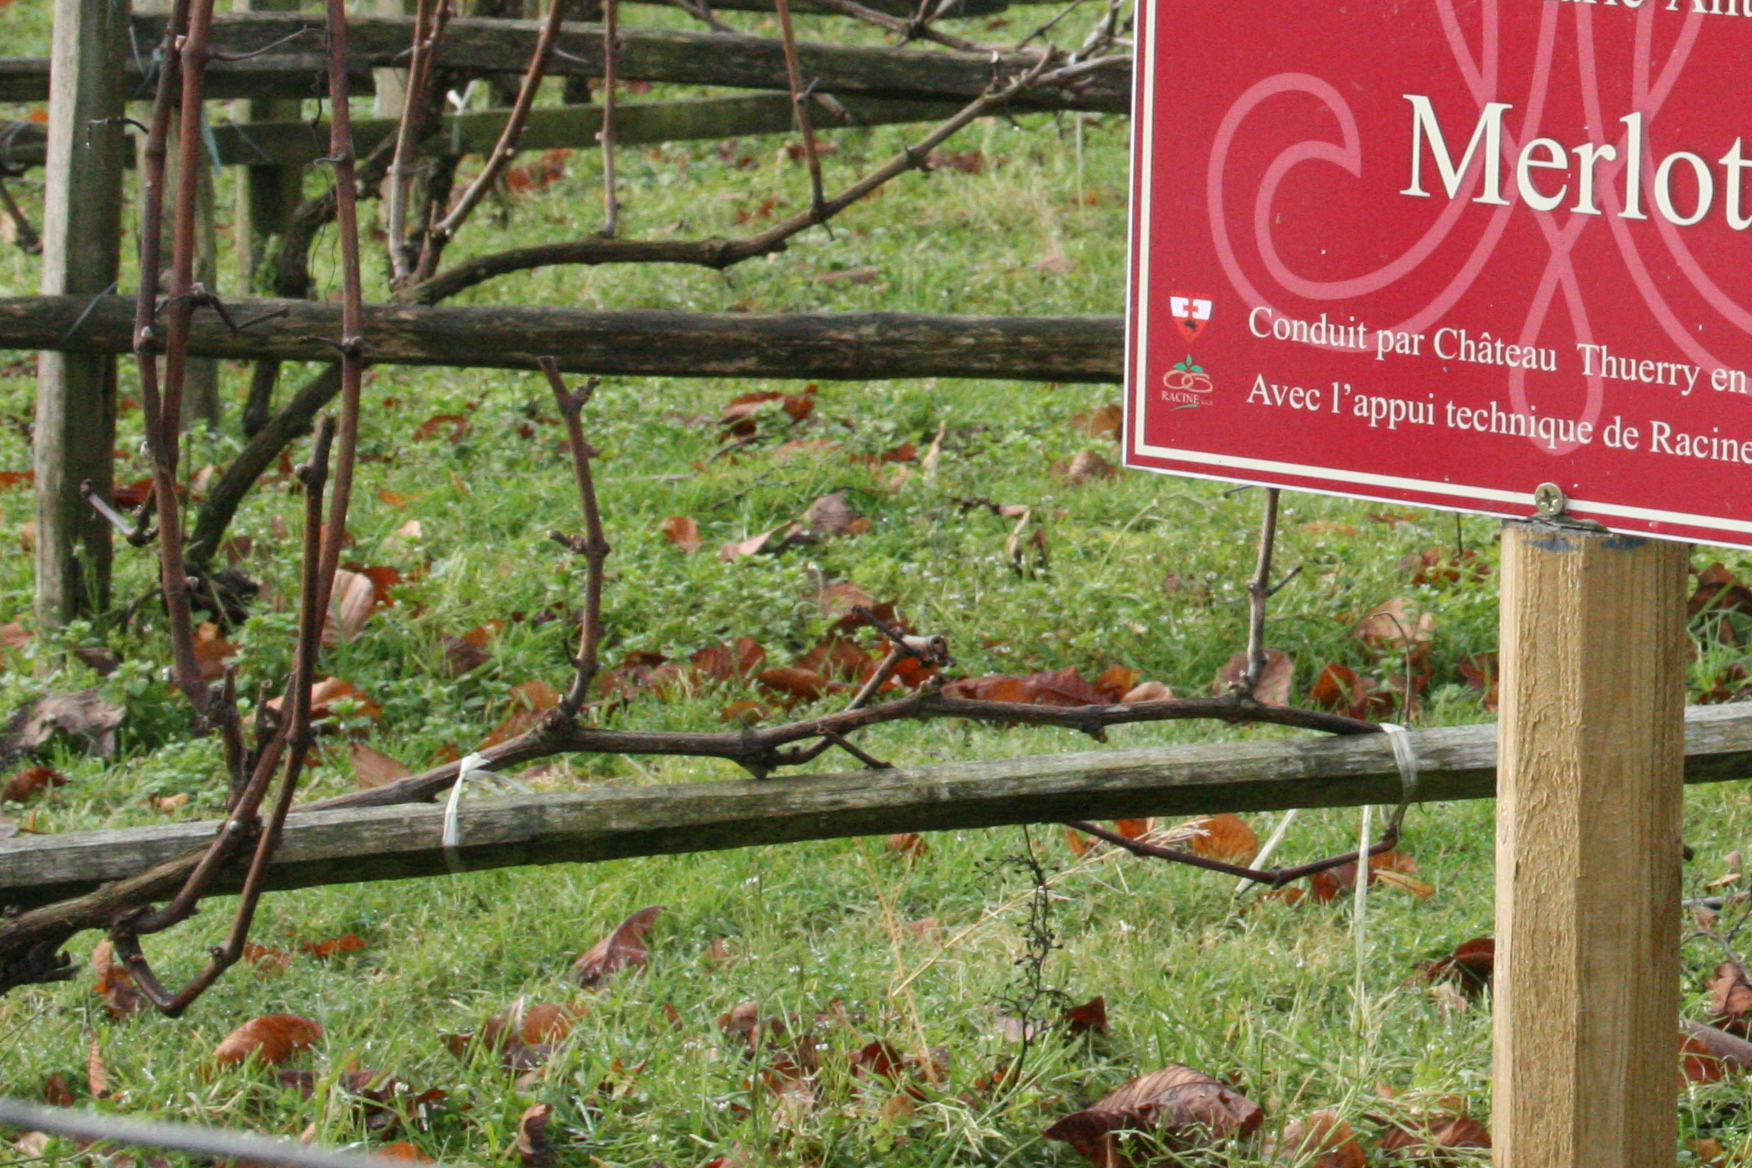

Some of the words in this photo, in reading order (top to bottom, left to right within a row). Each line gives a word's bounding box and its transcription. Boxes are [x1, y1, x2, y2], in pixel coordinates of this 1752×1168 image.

[1248, 306, 1367, 351] Conduit
[1376, 328, 1424, 361] par
[1433, 326, 1557, 373] Château
[1577, 343, 1700, 396] Thuerry
[1711, 368, 1748, 394] en
[1247, 373, 1321, 413] Avec
[1446, 401, 1593, 449] technique
[1603, 416, 1639, 449] de
